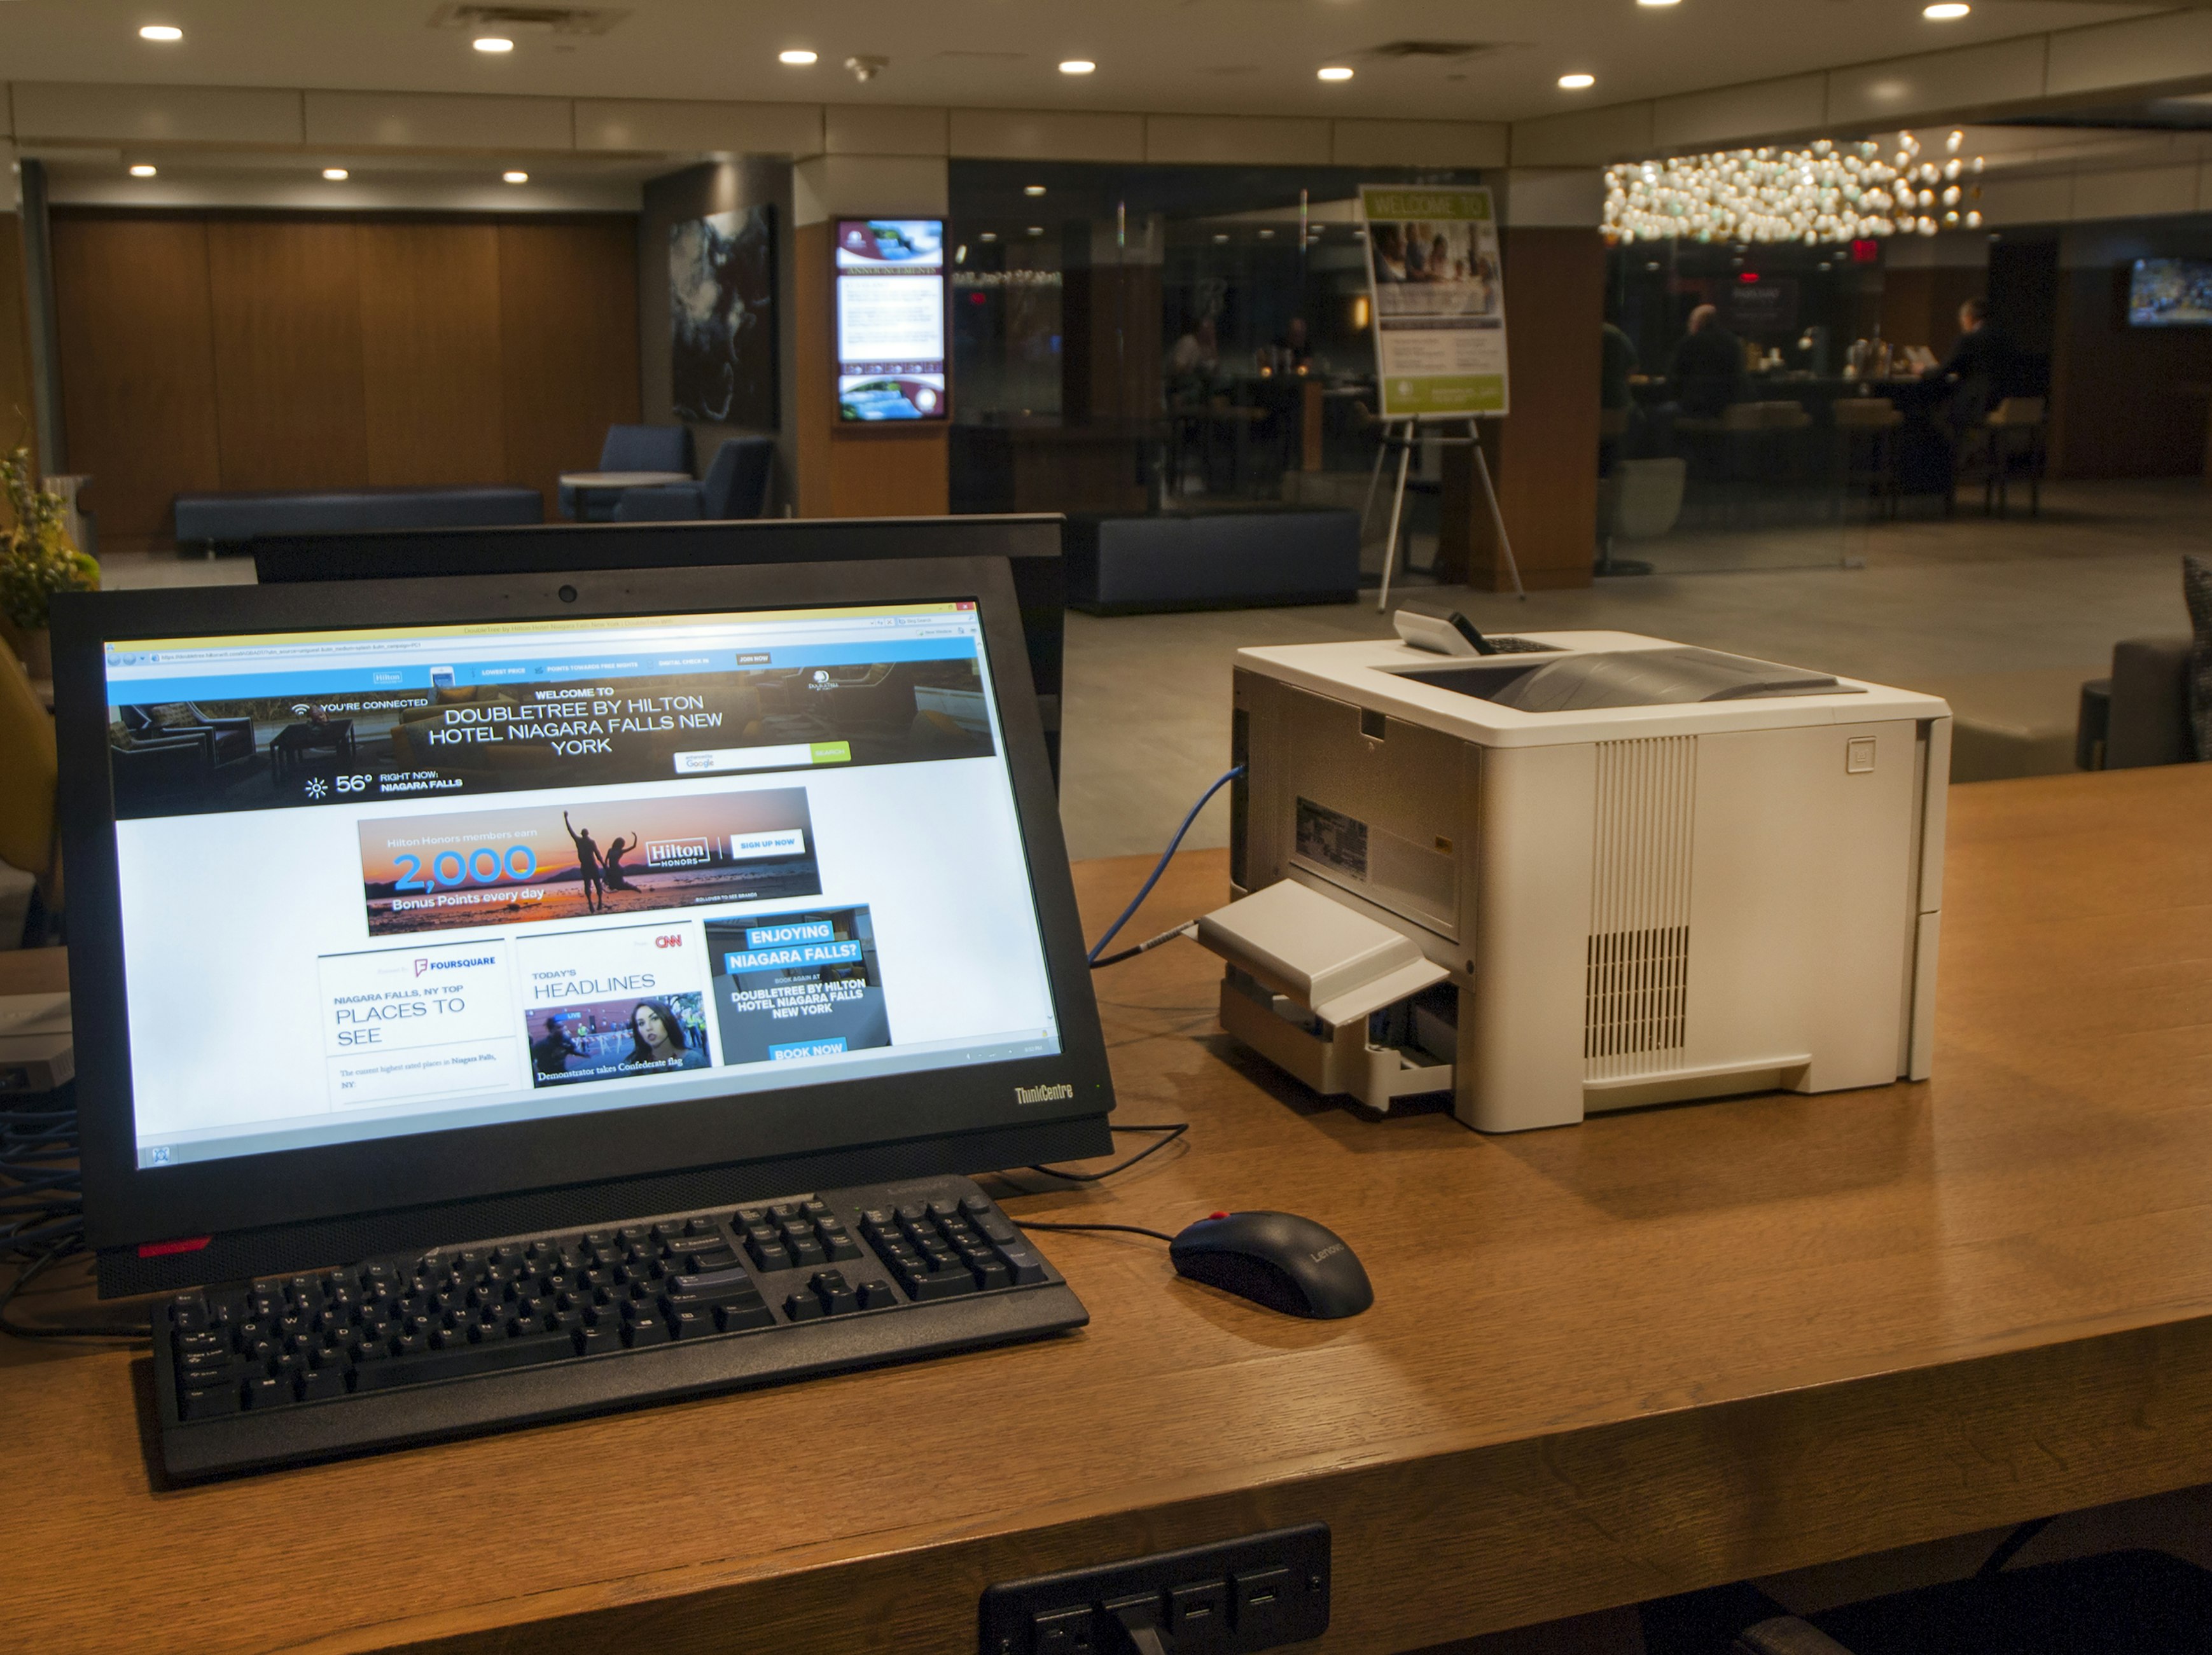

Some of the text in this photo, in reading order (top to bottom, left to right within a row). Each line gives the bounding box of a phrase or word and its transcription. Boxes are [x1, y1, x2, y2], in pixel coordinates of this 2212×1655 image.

[375, 674, 401, 682] Hilton
[536, 687, 615, 701] WELCOME TO
[321, 698, 429, 712] YOU'RE CONNECTED
[445, 695, 704, 726] DOUBLETREE BY HILTON
[428, 712, 723, 745] HOTEL NIAGARA FALLS NEW
[551, 738, 613, 756] YORK
[814, 749, 845, 757] SEARCH
[686, 759, 714, 768] Google
[380, 770, 438, 782] RIGHT NOW:
[381, 779, 463, 793] NIAGARA FALLS
[387, 829, 538, 848] Hilton Honors members earn
[740, 841, 762, 850] SIGN
[774, 838, 795, 847] NOW
[651, 843, 704, 860] Hilton
[393, 844, 538, 895] 2,000
[660, 858, 699, 868] HONORS
[392, 887, 545, 911] Bonus Points every day
[655, 934, 683, 948] CNN
[751, 925, 830, 945] ENJOYING
[431, 957, 496, 971] FOURSQUARE
[730, 944, 857, 969] NIAGARA FALLS?
[532, 969, 577, 980] TODAY'S
[793, 974, 812, 983] AGAIN
[333, 985, 464, 1005] NIAGARA FALLS, NY TOP
[534, 973, 656, 1000] HEADLINES
[731, 978, 866, 1004] DOUBLETREE BY HILTON
[737, 989, 864, 1013] HOTEL NIAGARA FALLS
[336, 997, 466, 1025] PLACES TO
[772, 1003, 833, 1020] NEW YORK
[337, 1027, 382, 1046] SEE
[774, 1043, 843, 1060] BOOK NOW
[340, 1069, 354, 1077] The
[355, 1066, 379, 1075] current
[380, 1063, 403, 1075] highest
[405, 1061, 422, 1071] rated
[422, 1060, 442, 1070] places
[451, 1055, 478, 1066] Niagara
[478, 1053, 497, 1063] Falls,
[538, 1056, 683, 1082] Demonstrator takes Confederate flag
[1015, 1084, 1074, 1105] ThinkCentre
[1311, 1243, 1344, 1263] Lenovo
